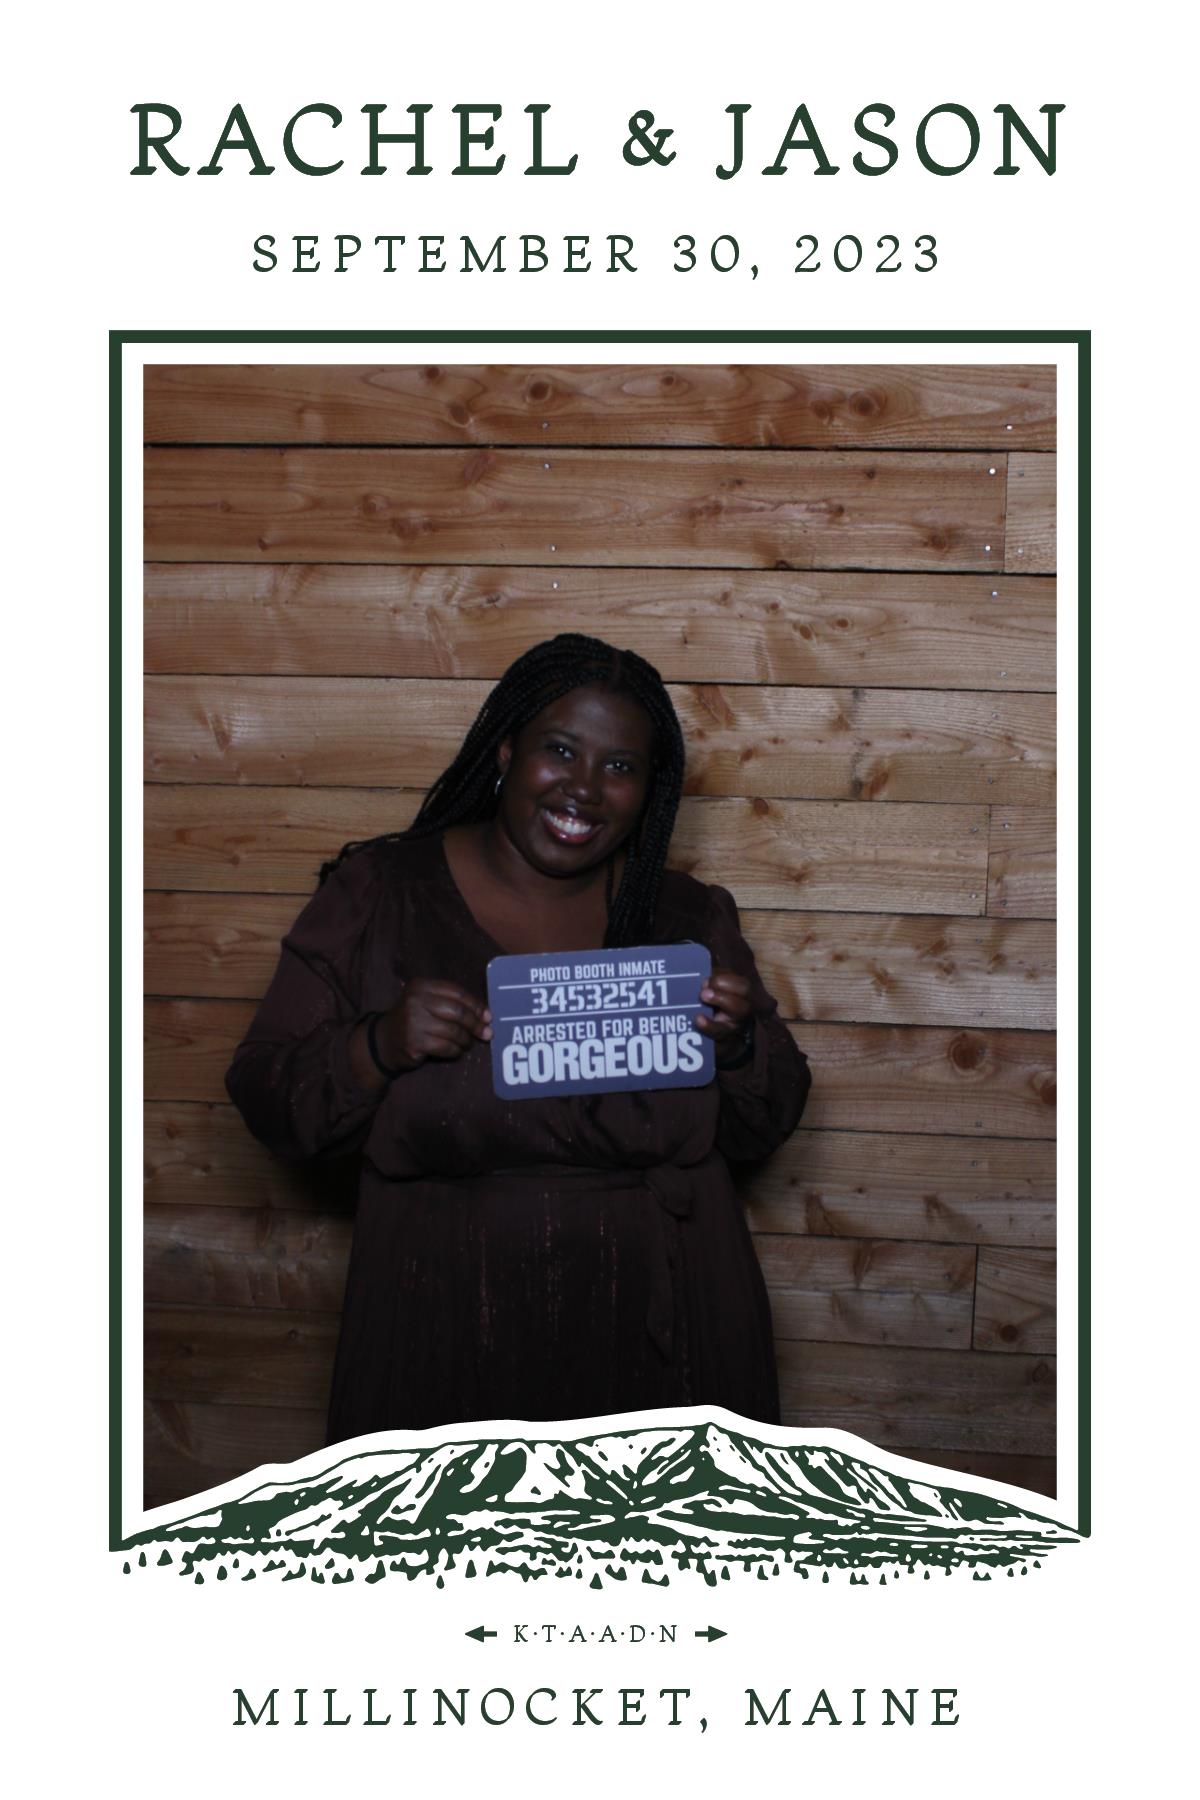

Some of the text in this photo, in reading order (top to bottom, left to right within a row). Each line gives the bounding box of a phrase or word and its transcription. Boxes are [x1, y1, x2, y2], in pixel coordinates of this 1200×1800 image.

[530, 960, 666, 983] PHOTO BOOTH INMATE
[531, 979, 669, 1014] 34532541
[511, 1014, 693, 1044] ARRESTED FOR BEING:
[502, 1032, 704, 1086] GORGEOUS
